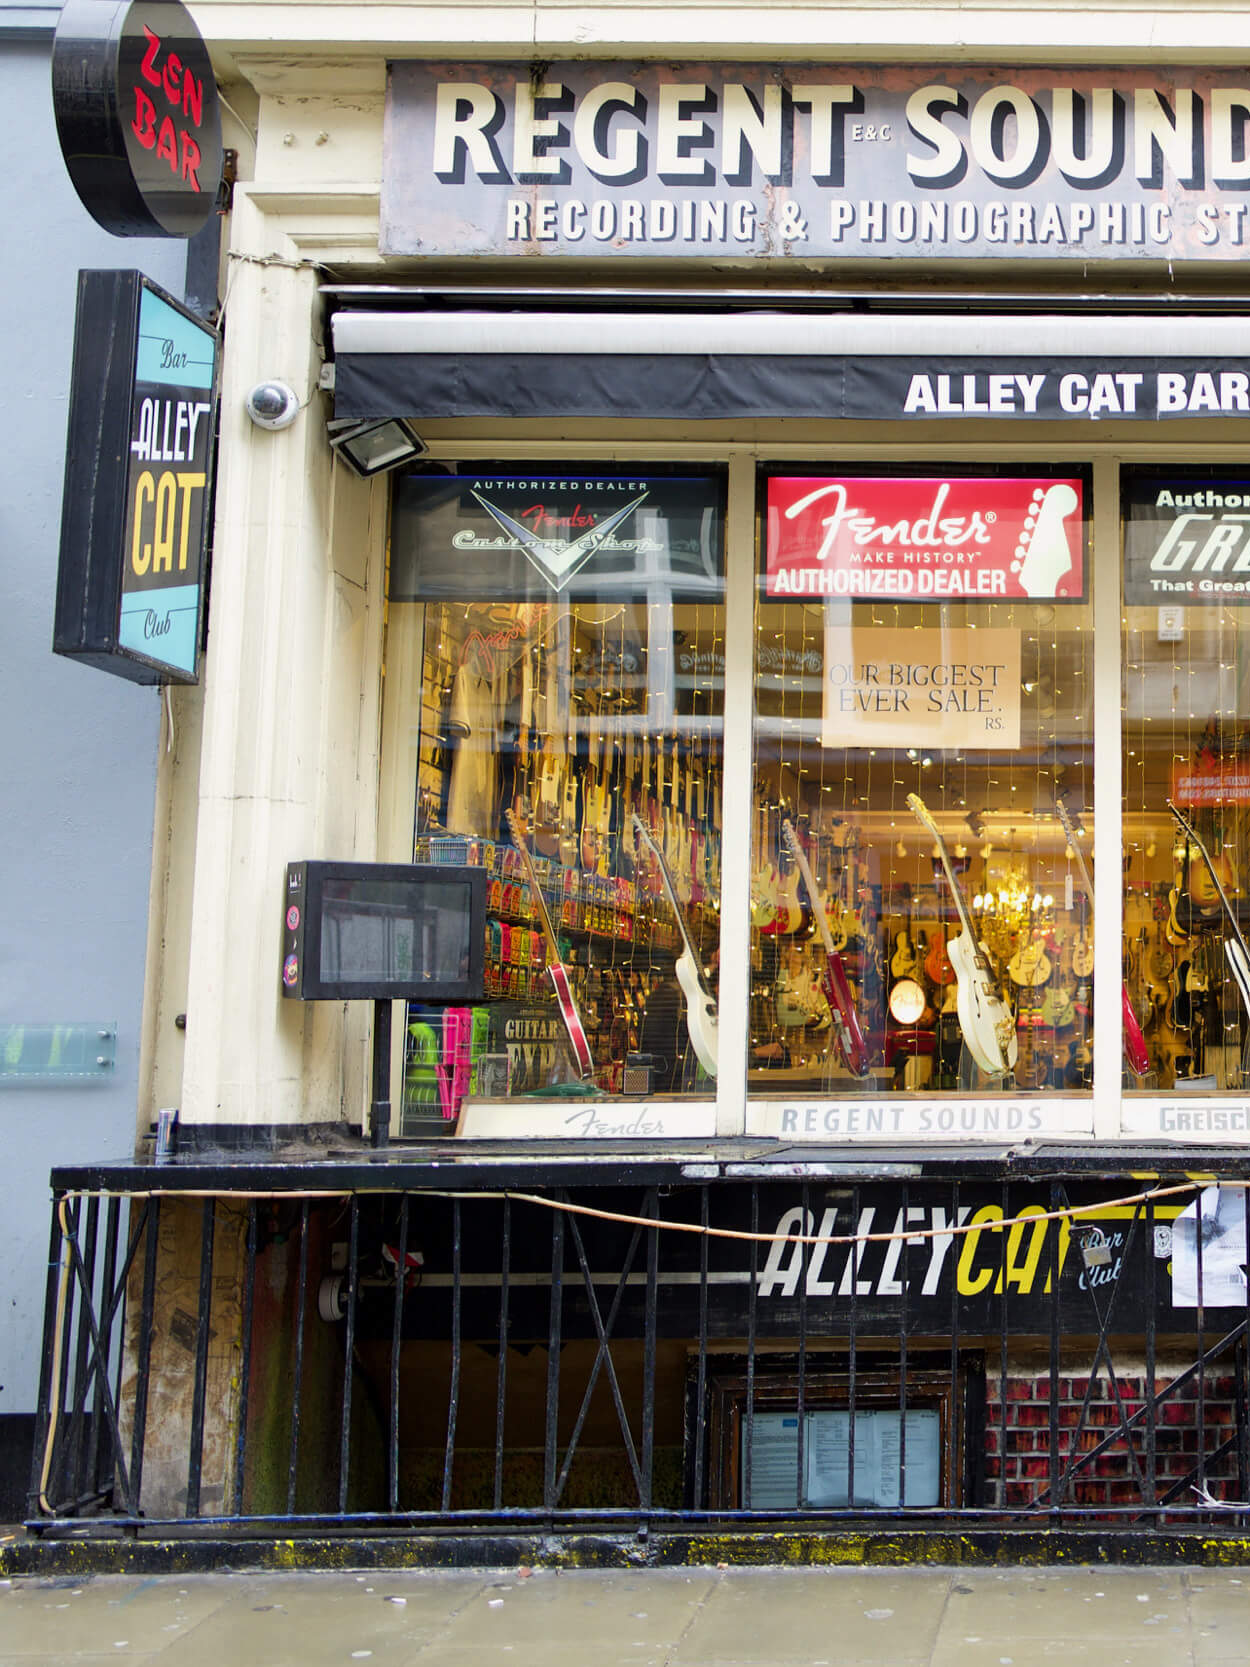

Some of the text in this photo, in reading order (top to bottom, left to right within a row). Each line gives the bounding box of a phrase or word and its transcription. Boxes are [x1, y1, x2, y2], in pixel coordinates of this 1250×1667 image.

[140, 24, 203, 127] ZEN
[131, 86, 201, 192] BAR
[432, 82, 858, 182] REGENT
[507, 199, 758, 242] RECORDING
[777, 201, 809, 241] &
[830, 201, 1173, 245] PHONOGRAPHIC
[159, 338, 189, 369] Bar
[904, 373, 1046, 413] ALLEY
[1059, 373, 1143, 414] CAT
[1156, 373, 1250, 413] BAR
[130, 397, 210, 462] ALLEY
[473, 480, 647, 491] AUTHORIZED DEALER
[132, 471, 206, 576] CAT
[452, 529, 569, 551] Custom
[849, 552, 894, 563] MAKE
[773, 568, 1006, 594] AUTHORIZED DEALER
[1150, 580, 1194, 592] That
[144, 607, 171, 641] Club
[830, 664, 1006, 686] OUR BIGGEST
[839, 689, 911, 712] EVER
[504, 1019, 559, 1040] GUITAR
[565, 1107, 665, 1137] Fender
[781, 1107, 1043, 1133] REGENT SOUNDS
